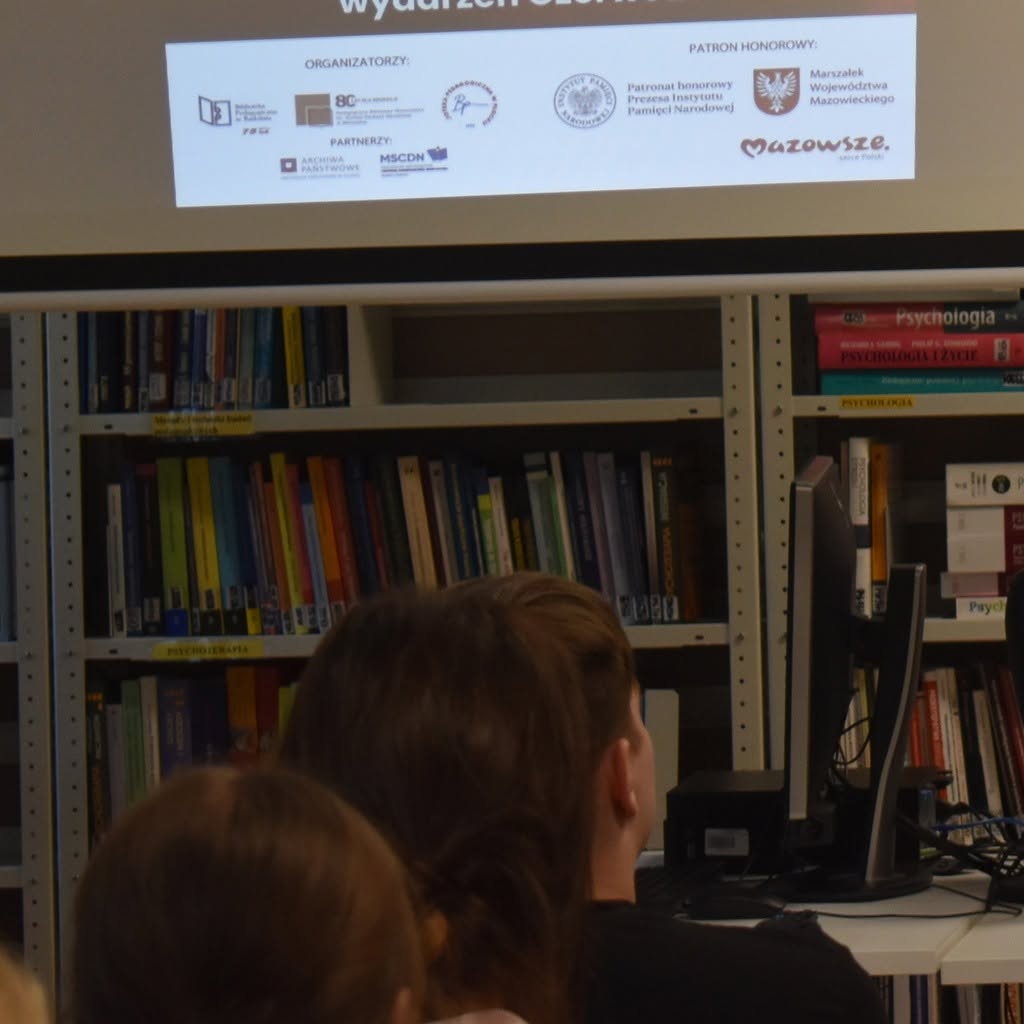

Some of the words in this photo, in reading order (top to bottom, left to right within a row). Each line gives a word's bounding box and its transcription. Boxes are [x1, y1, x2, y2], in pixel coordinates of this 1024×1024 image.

[689, 42, 738, 54] PATRON
[742, 39, 819, 53] HONOROWY:
[304, 55, 411, 70] ORGANIZATORZY:
[810, 67, 865, 79] Marszałek
[628, 83, 675, 92] Patronat
[677, 79, 734, 92] honorowy
[810, 79, 889, 93] Województwa
[628, 93, 669, 104] Prezesa
[672, 92, 724, 103] Instytutu
[810, 93, 896, 106] Mazowieckiego
[628, 105, 672, 117] Pamięci
[675, 103, 735, 116] Narodowej
[330, 136, 393, 147] PARTNERZY:
[380, 152, 425, 163] MSCDN
[896, 307, 996, 329] Psychologia
[841, 350, 929, 364] PSYCHOLOGIA
[841, 398, 914, 408] PSYCHOLOGIA
